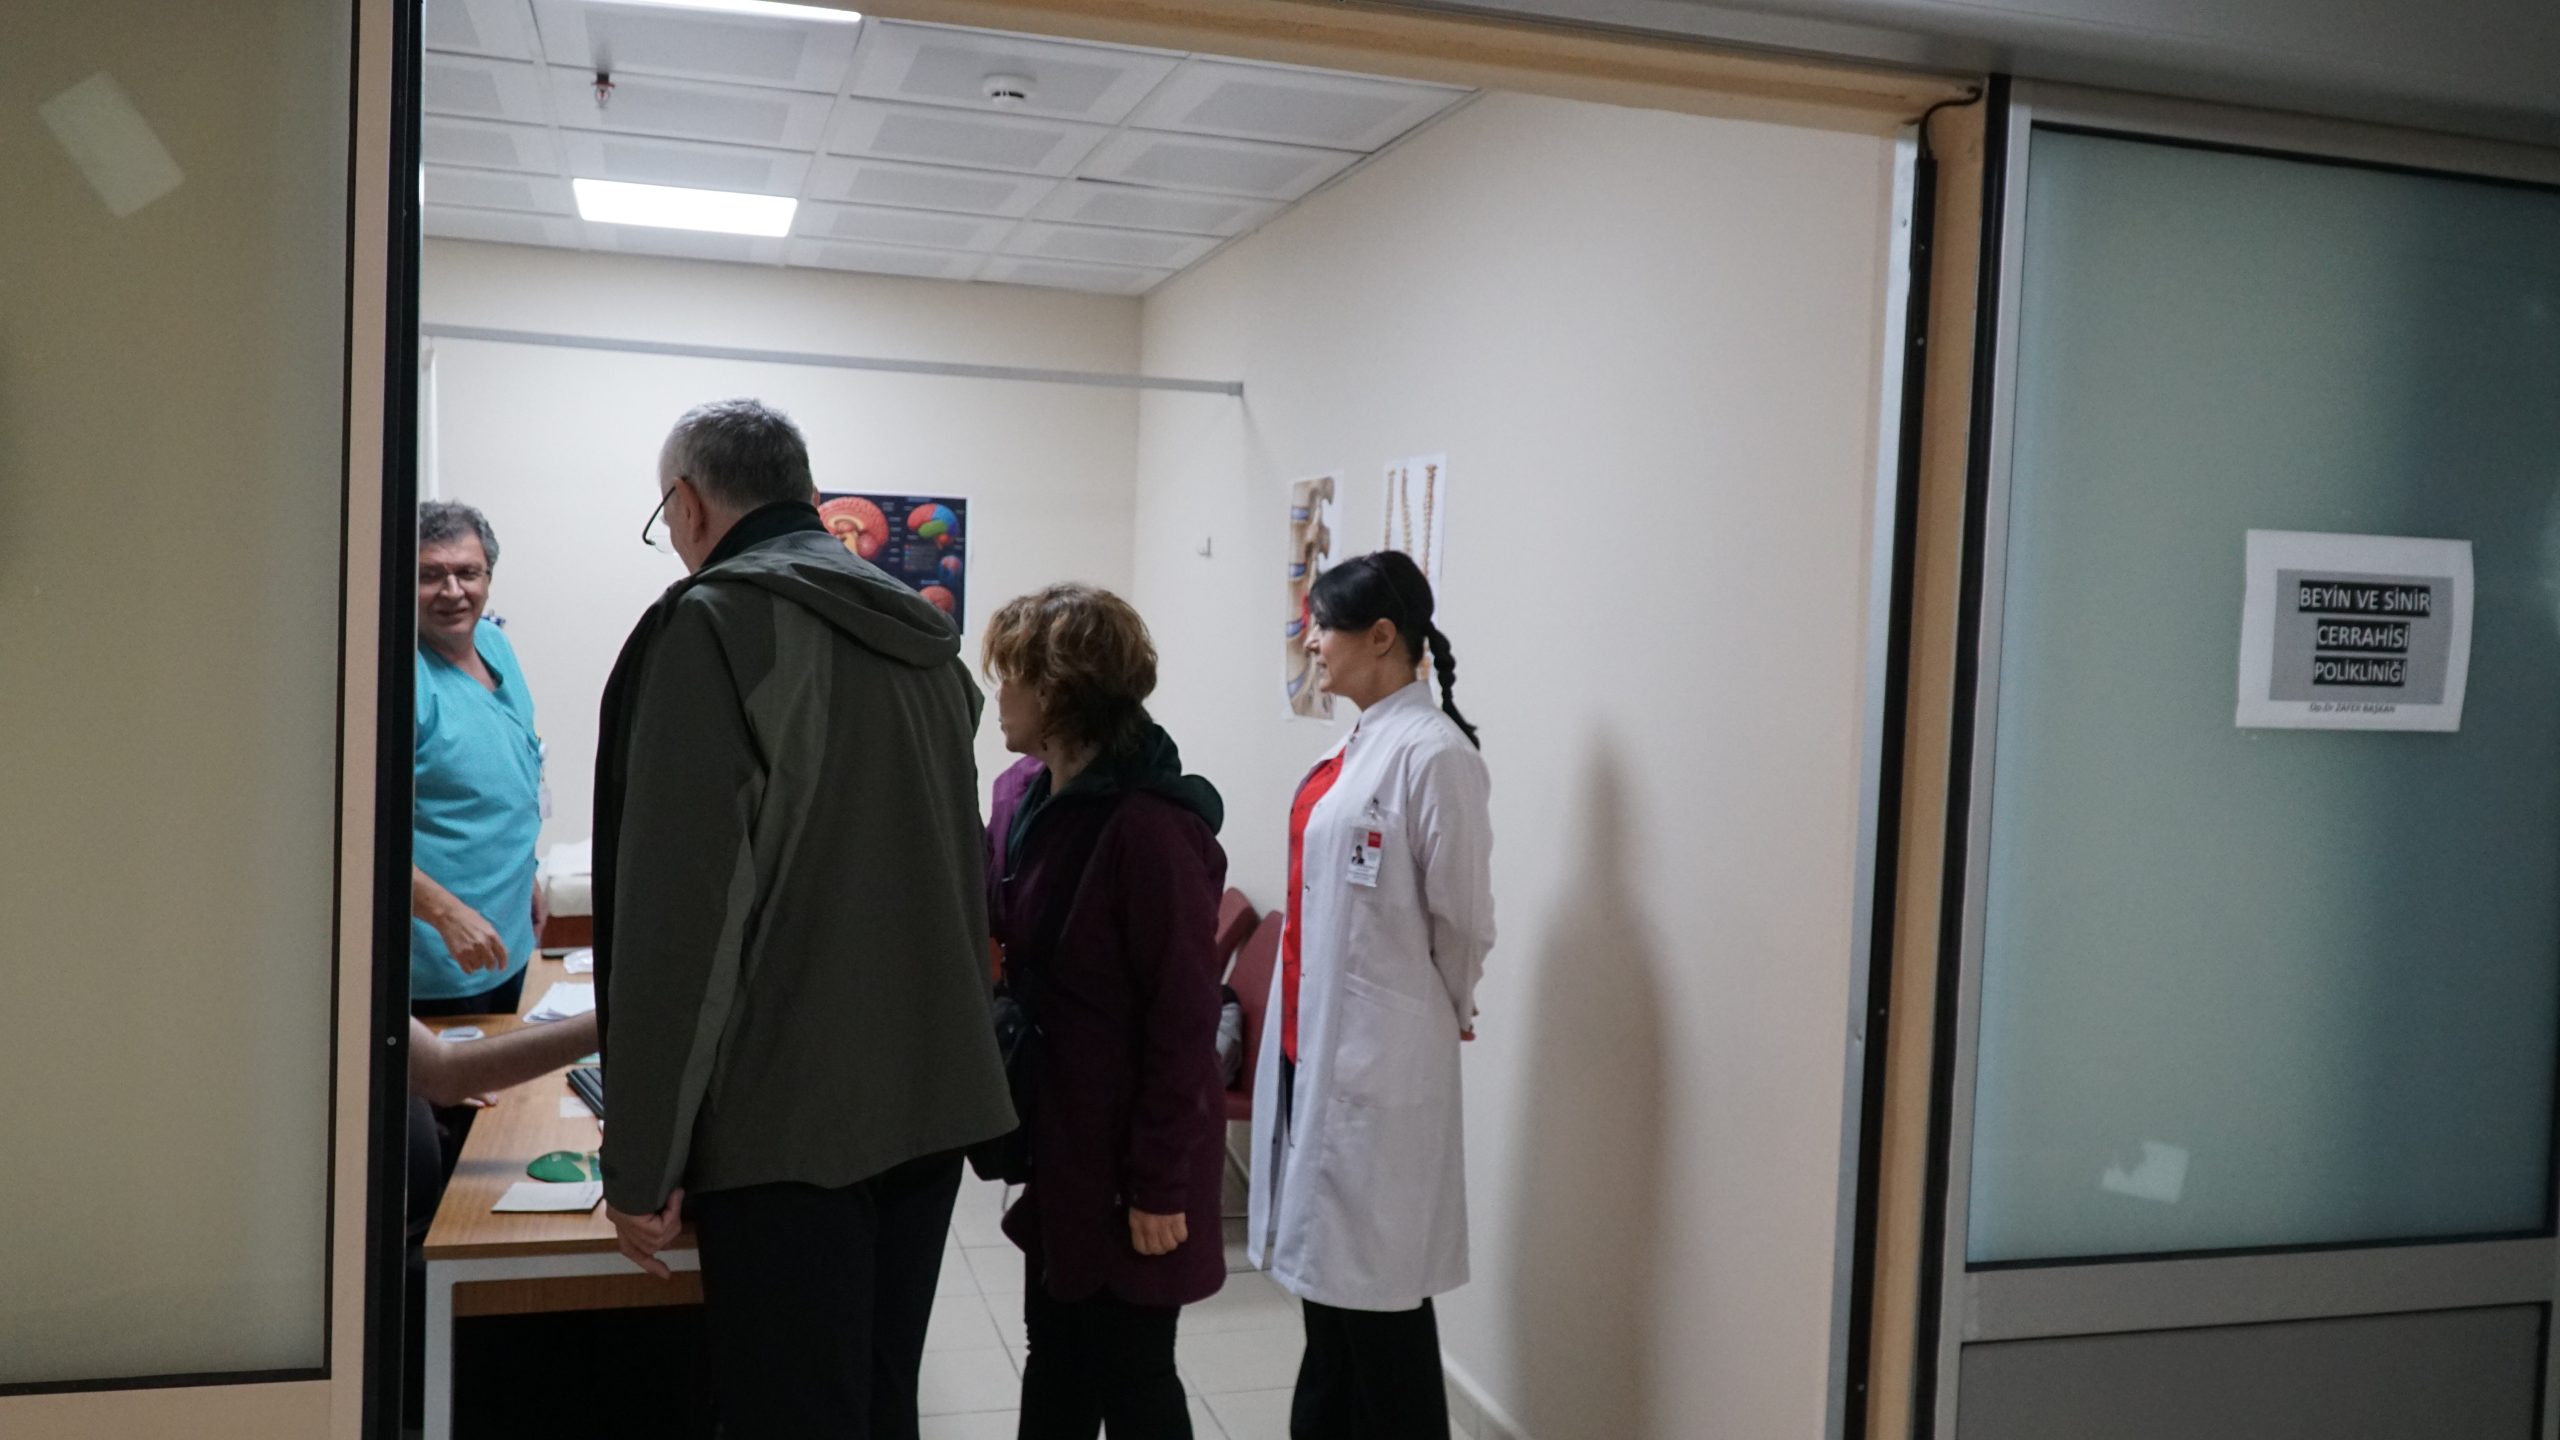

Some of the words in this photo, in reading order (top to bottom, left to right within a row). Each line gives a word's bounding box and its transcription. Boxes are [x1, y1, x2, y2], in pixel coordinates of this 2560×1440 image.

[2300, 585, 2351, 608] BEYİN
[2356, 590, 2379, 610] VE
[2384, 587, 2431, 613] SİNİR
[2317, 624, 2409, 649] CERRAHİSİ
[2315, 660, 2406, 683] POLİKLİNİĞİ
